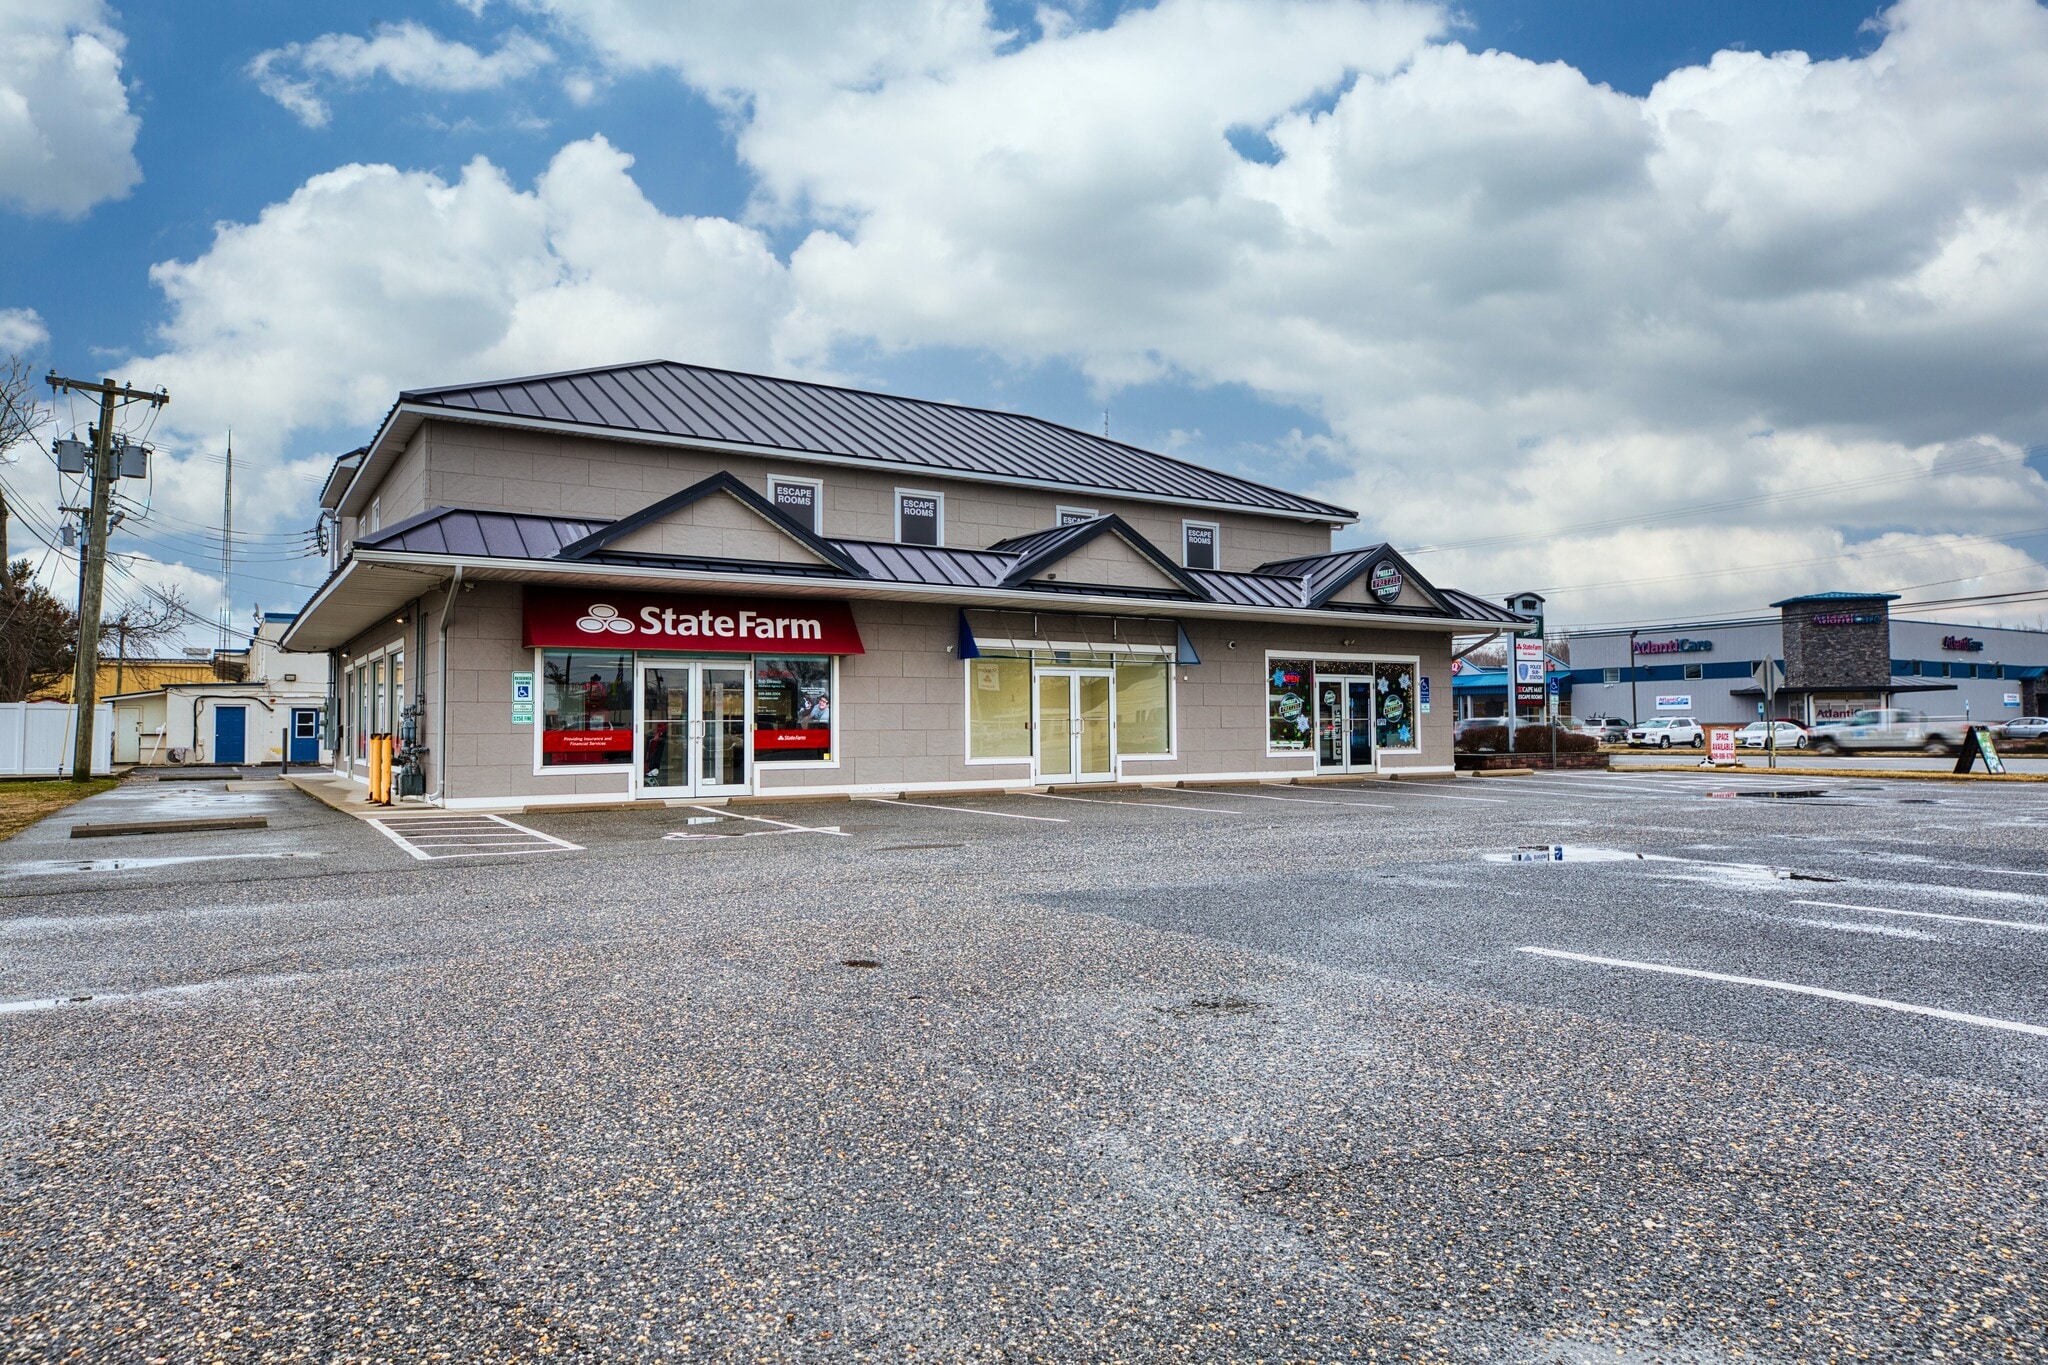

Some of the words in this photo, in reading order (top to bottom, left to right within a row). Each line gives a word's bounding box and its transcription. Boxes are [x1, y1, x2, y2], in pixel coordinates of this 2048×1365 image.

[777, 487, 812, 498] ESCAPE
[778, 495, 811, 506] ROOMS
[903, 500, 935, 510] ESCAPE
[904, 508, 934, 518] ROOMS
[1187, 529, 1212, 538] ESCAPE
[1188, 536, 1212, 545] ROOMS
[1376, 568, 1395, 578] PHILLY
[1374, 576, 1400, 588] PRETZEL
[1377, 585, 1400, 596] FACTORY
[640, 606, 735, 638] State
[739, 611, 822, 640] Farm
[1813, 613, 1881, 625] AtlantiCare
[1632, 638, 1713, 655] AtlantiCare
[1715, 732, 1729, 740] SPACE
